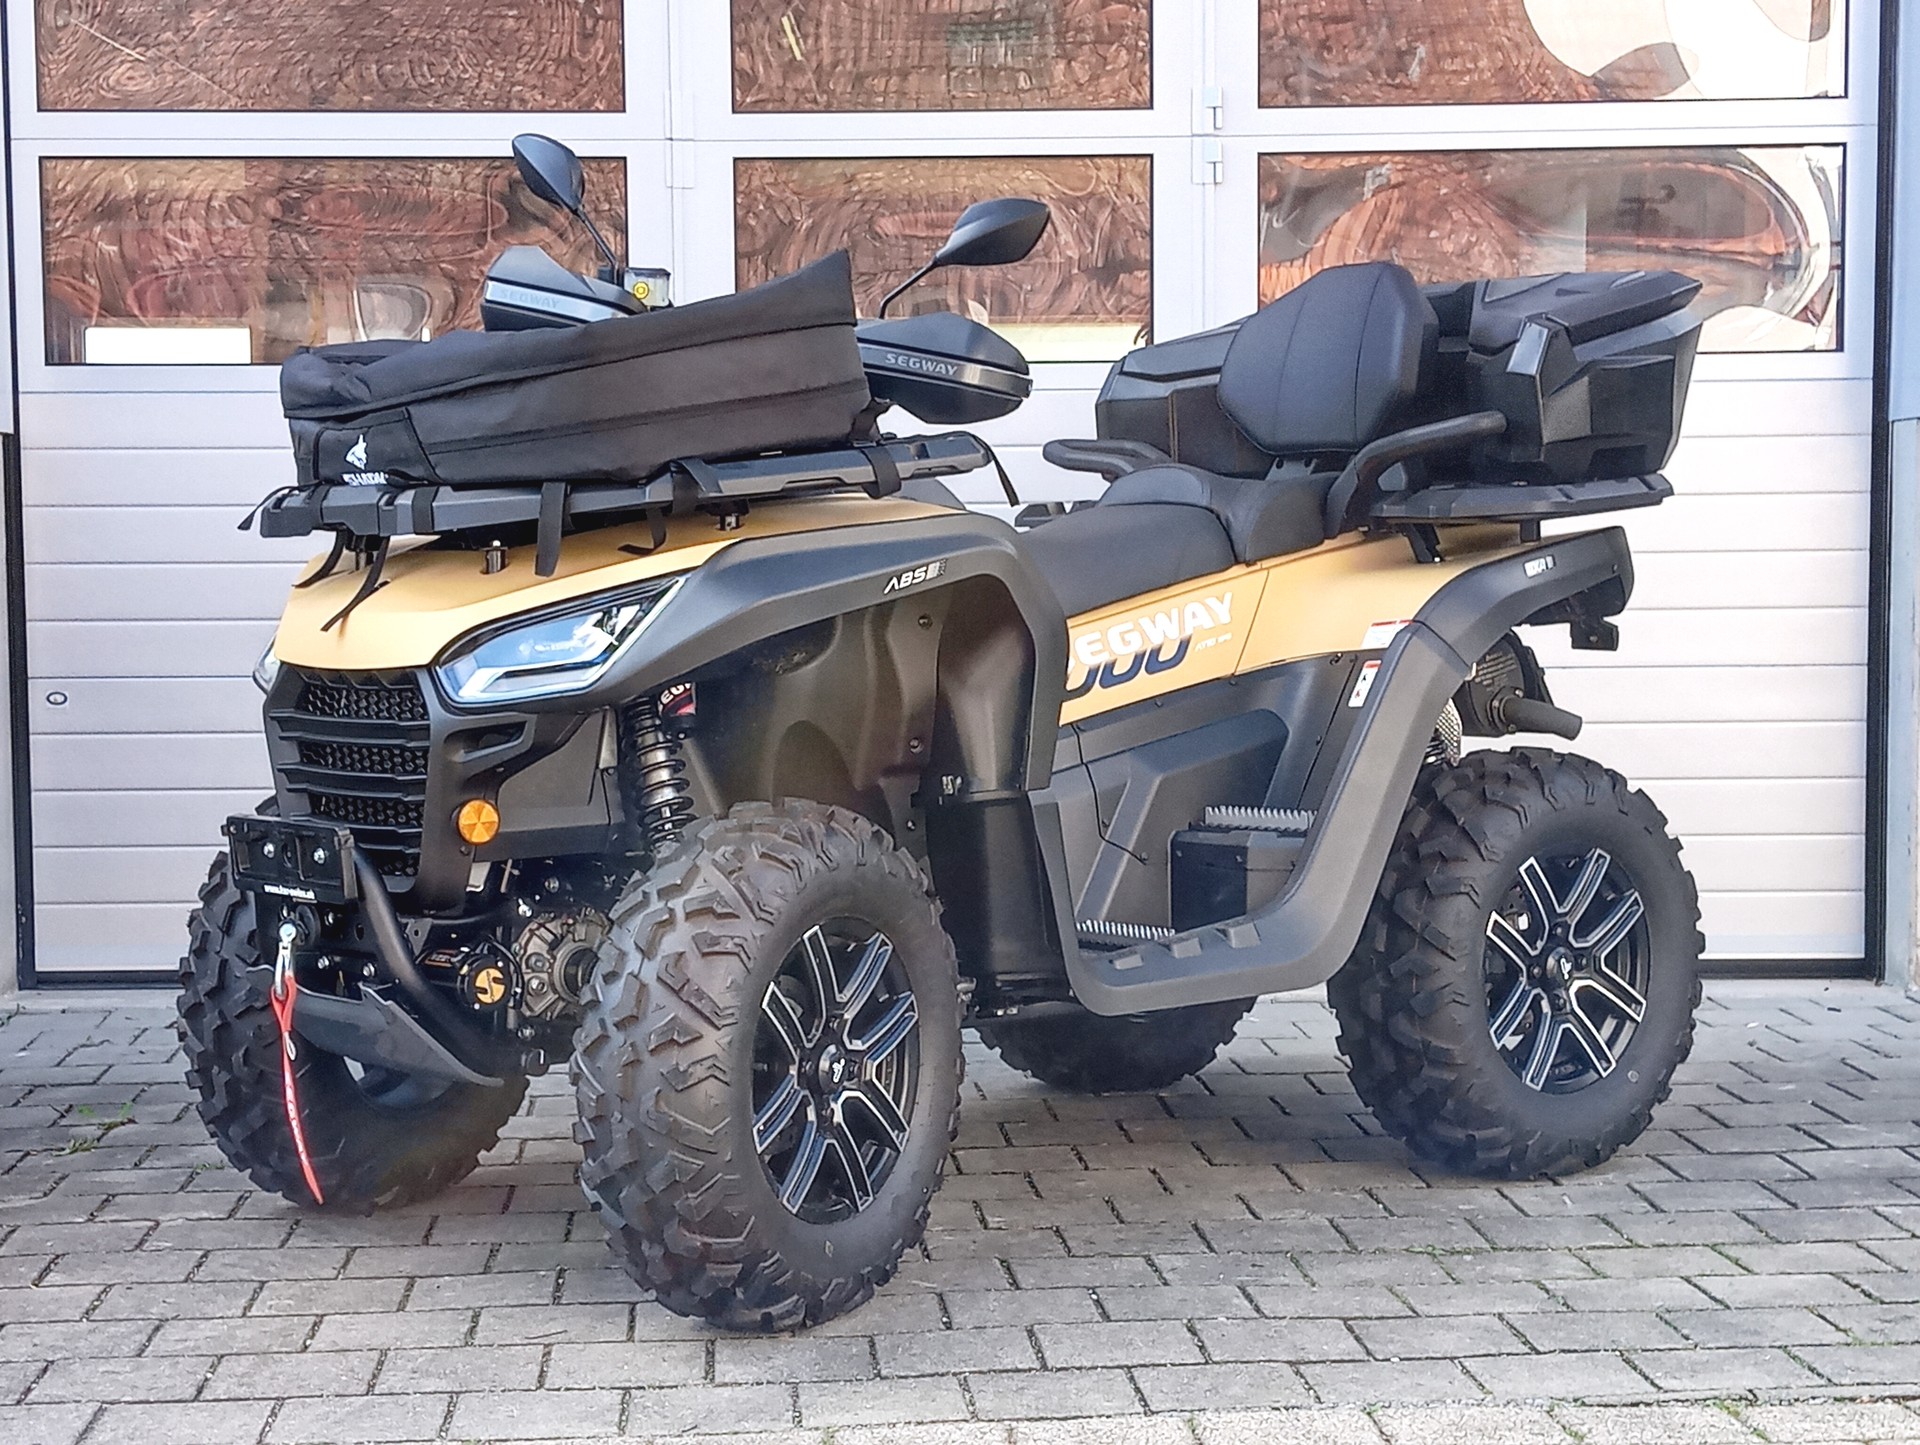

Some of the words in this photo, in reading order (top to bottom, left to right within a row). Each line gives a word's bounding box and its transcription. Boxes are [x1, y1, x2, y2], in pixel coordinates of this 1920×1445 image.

[885, 352, 958, 376] SEGWAY
[883, 565, 927, 595] ABS
[1067, 591, 1233, 673] EGWAY
